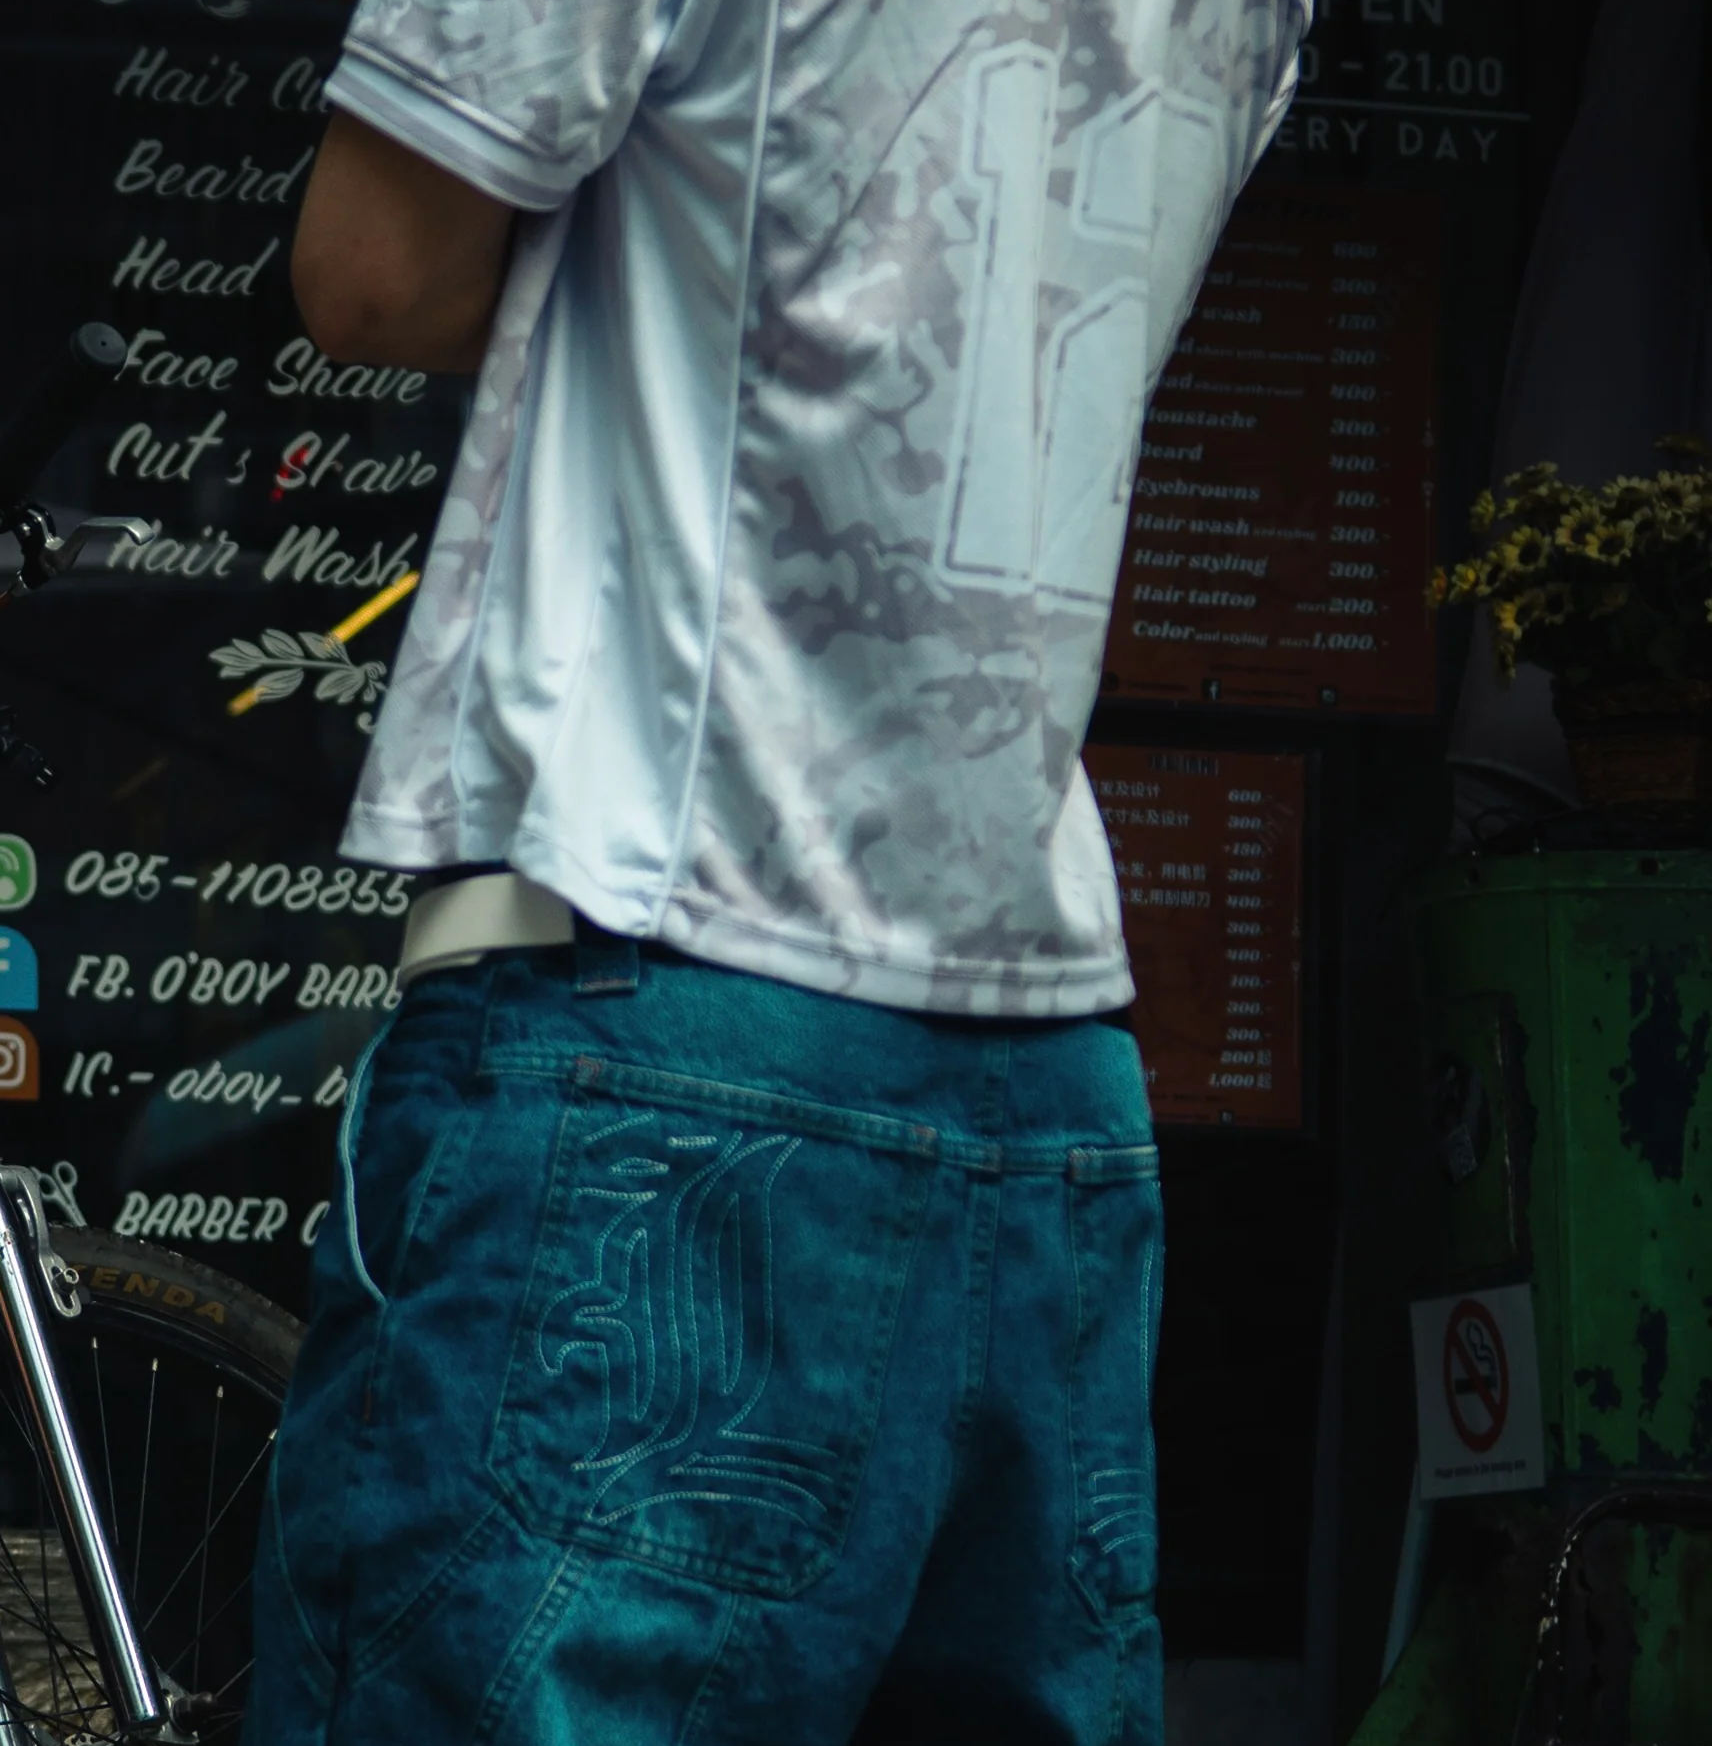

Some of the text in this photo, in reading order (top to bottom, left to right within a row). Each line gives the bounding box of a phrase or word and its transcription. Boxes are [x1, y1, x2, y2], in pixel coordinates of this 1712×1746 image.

[112, 44, 250, 109] Hair
[1384, 49, 1504, 98] 21.00
[1274, 114, 1498, 163] ERY DAY
[113, 137, 316, 204] Beard
[110, 234, 281, 298] Head
[113, 327, 430, 407] Face Shave
[1133, 512, 1187, 534] Hair
[1188, 516, 1251, 538] wash
[261, 523, 422, 589] Wash
[1132, 548, 1186, 570] Hair
[1188, 553, 1269, 579] styling
[1131, 584, 1186, 605] Hair
[1187, 587, 1258, 610] tattoo
[1131, 619, 1196, 642] Color
[64, 849, 417, 919] 085-1108855
[66, 953, 136, 1002] FB.
[149, 950, 291, 1008] O'BOY
[113, 1189, 290, 1245] BARBER
